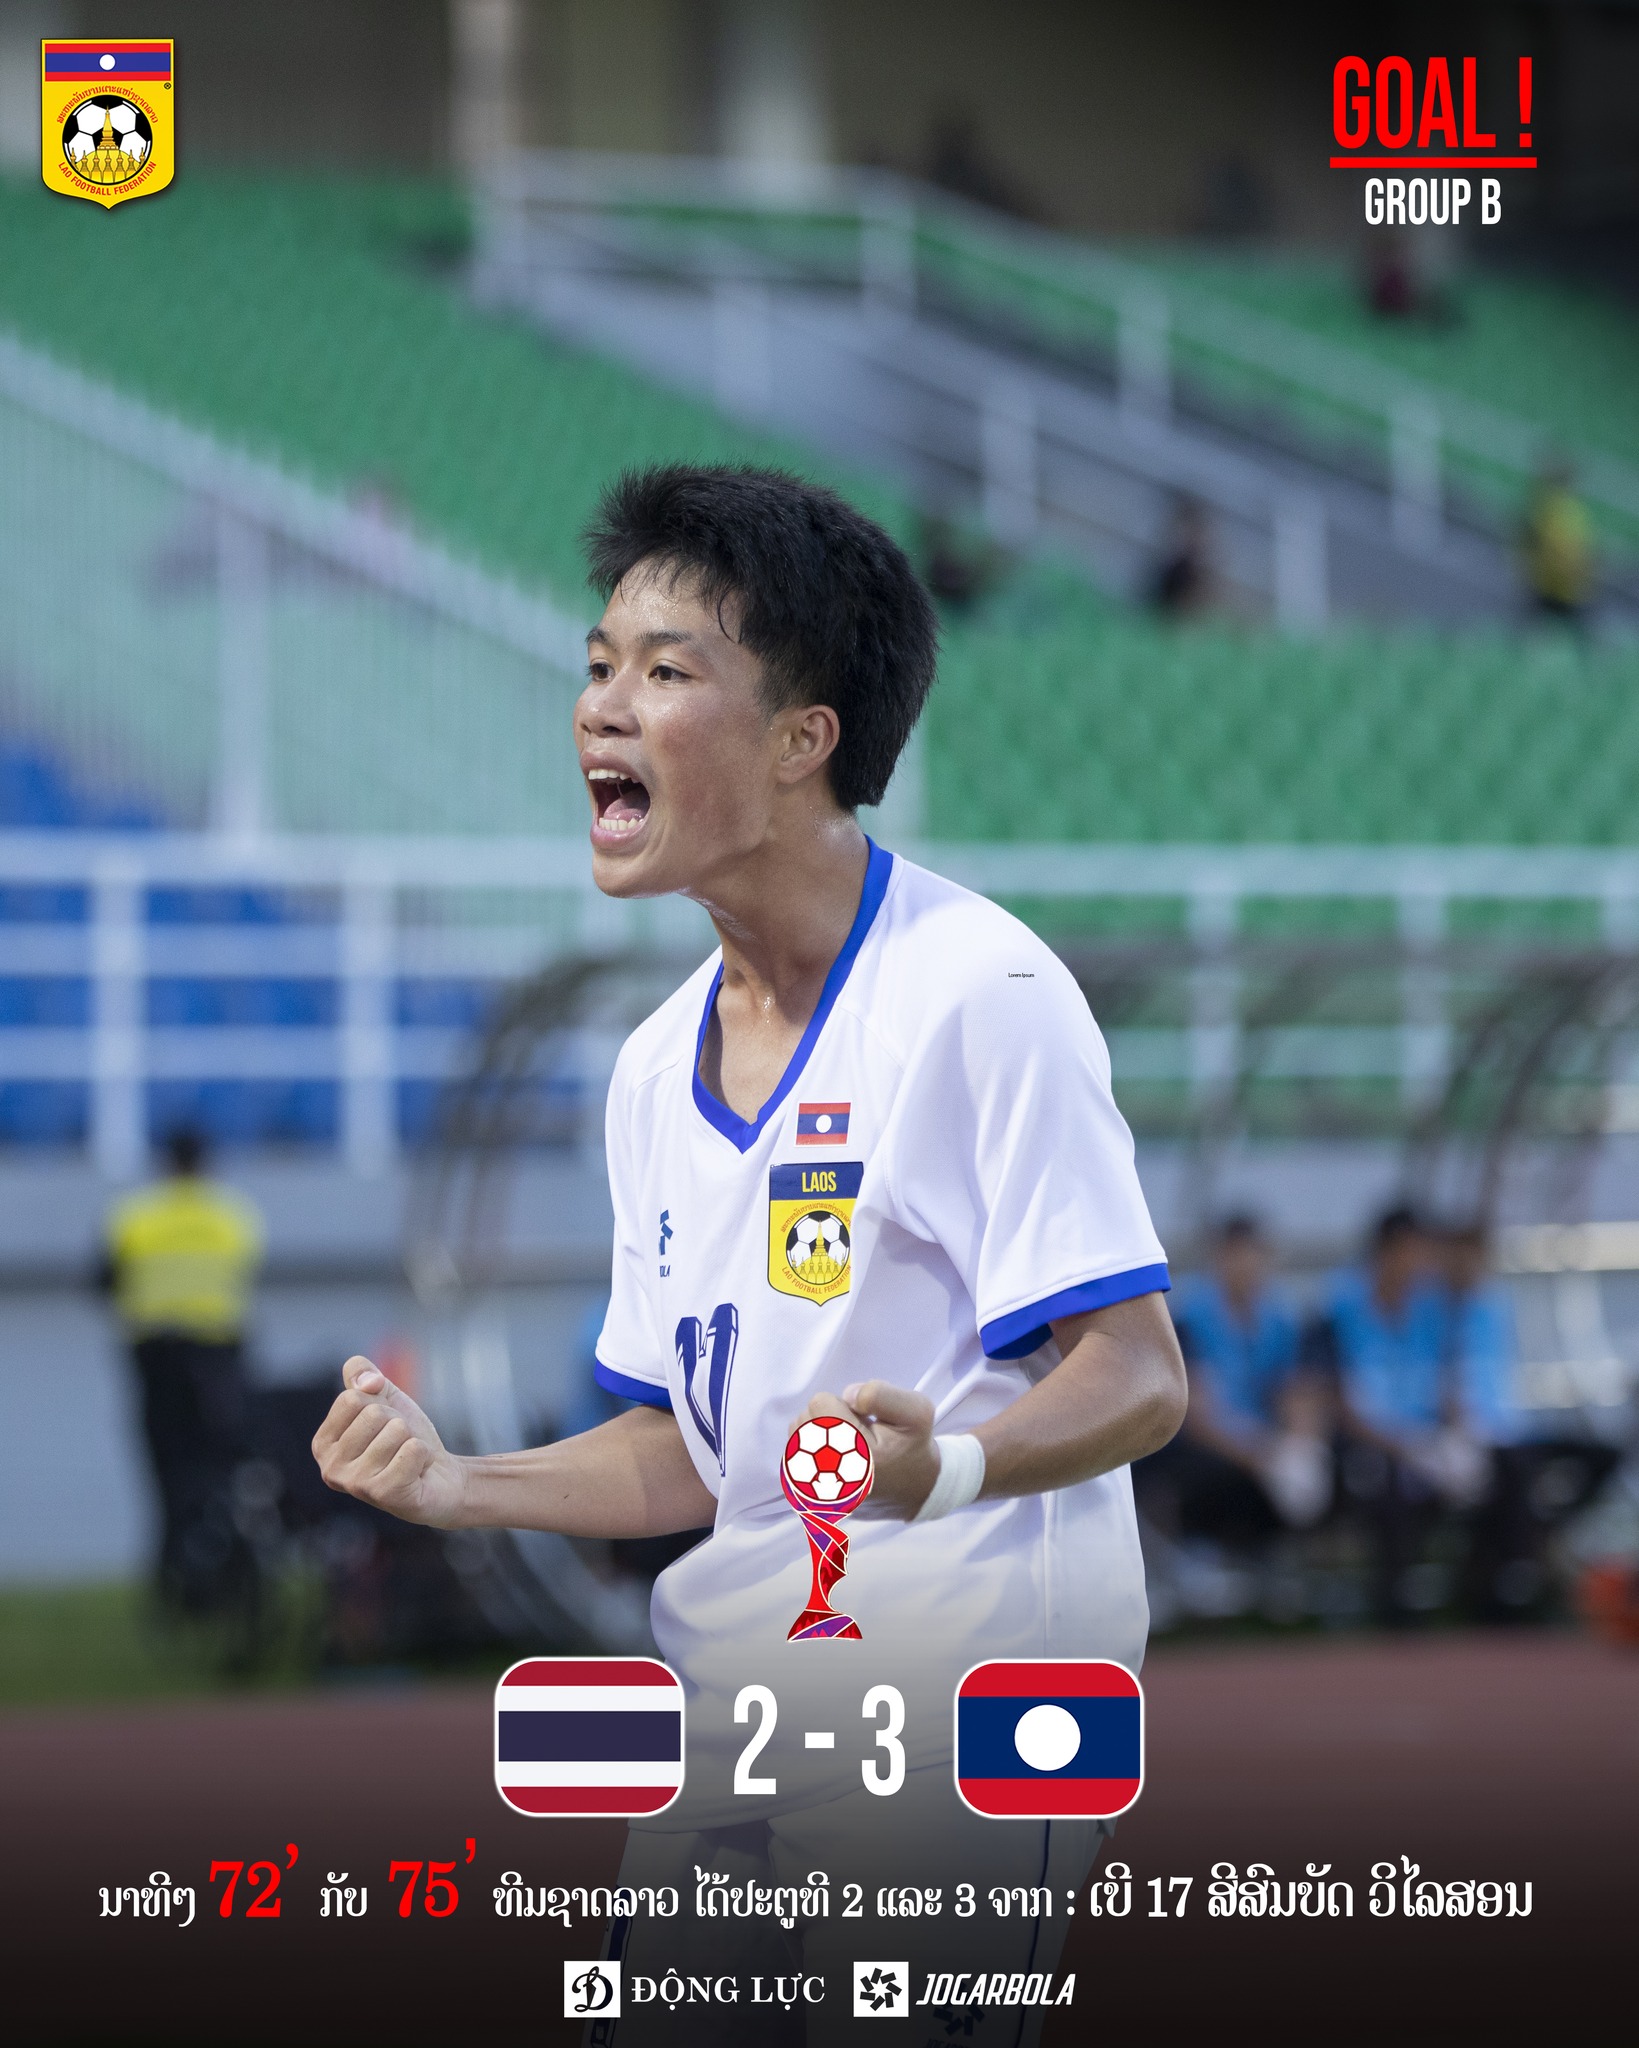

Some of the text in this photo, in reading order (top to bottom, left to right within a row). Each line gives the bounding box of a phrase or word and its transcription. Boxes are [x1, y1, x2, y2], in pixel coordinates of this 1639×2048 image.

[801, 1171, 837, 1193] LAOS
[781, 1265, 851, 1294] LAO FOOTBALL FEDERATION
